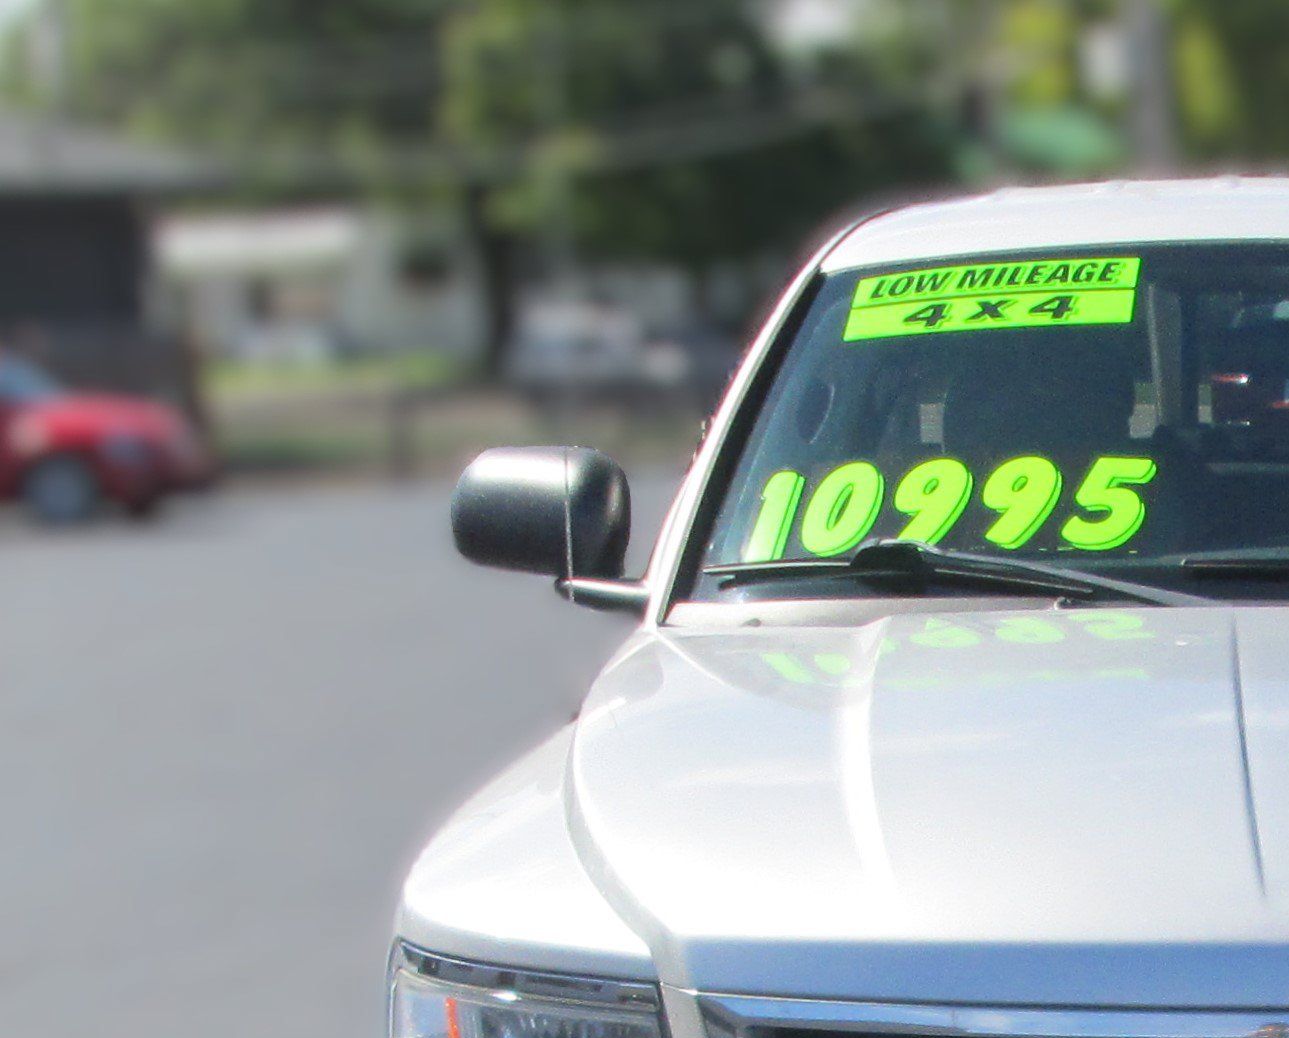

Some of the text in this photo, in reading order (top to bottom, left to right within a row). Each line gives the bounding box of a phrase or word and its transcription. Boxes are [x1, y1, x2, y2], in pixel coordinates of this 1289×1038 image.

[869, 261, 1121, 299] LOW MILEAGE
[746, 456, 1157, 561] 10995
